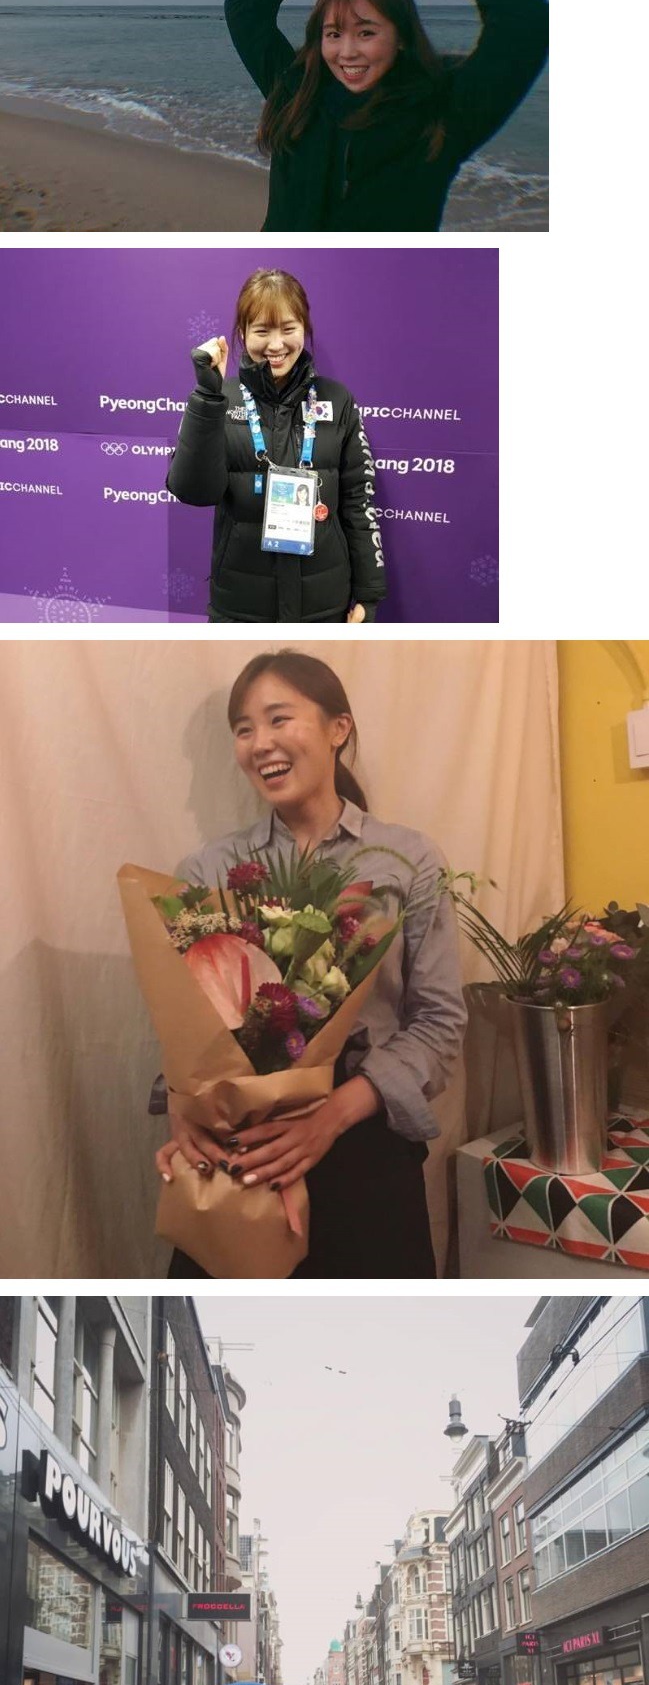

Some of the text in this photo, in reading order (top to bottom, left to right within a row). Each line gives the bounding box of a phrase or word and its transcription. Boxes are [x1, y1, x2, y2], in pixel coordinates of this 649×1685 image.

[100, 395, 188, 413] PyeongCha
[27, 438, 59, 452] 2018
[412, 457, 455, 474] 2018
[104, 487, 181, 505] PyeongCh
[573, 1634, 591, 1650] PARIS
